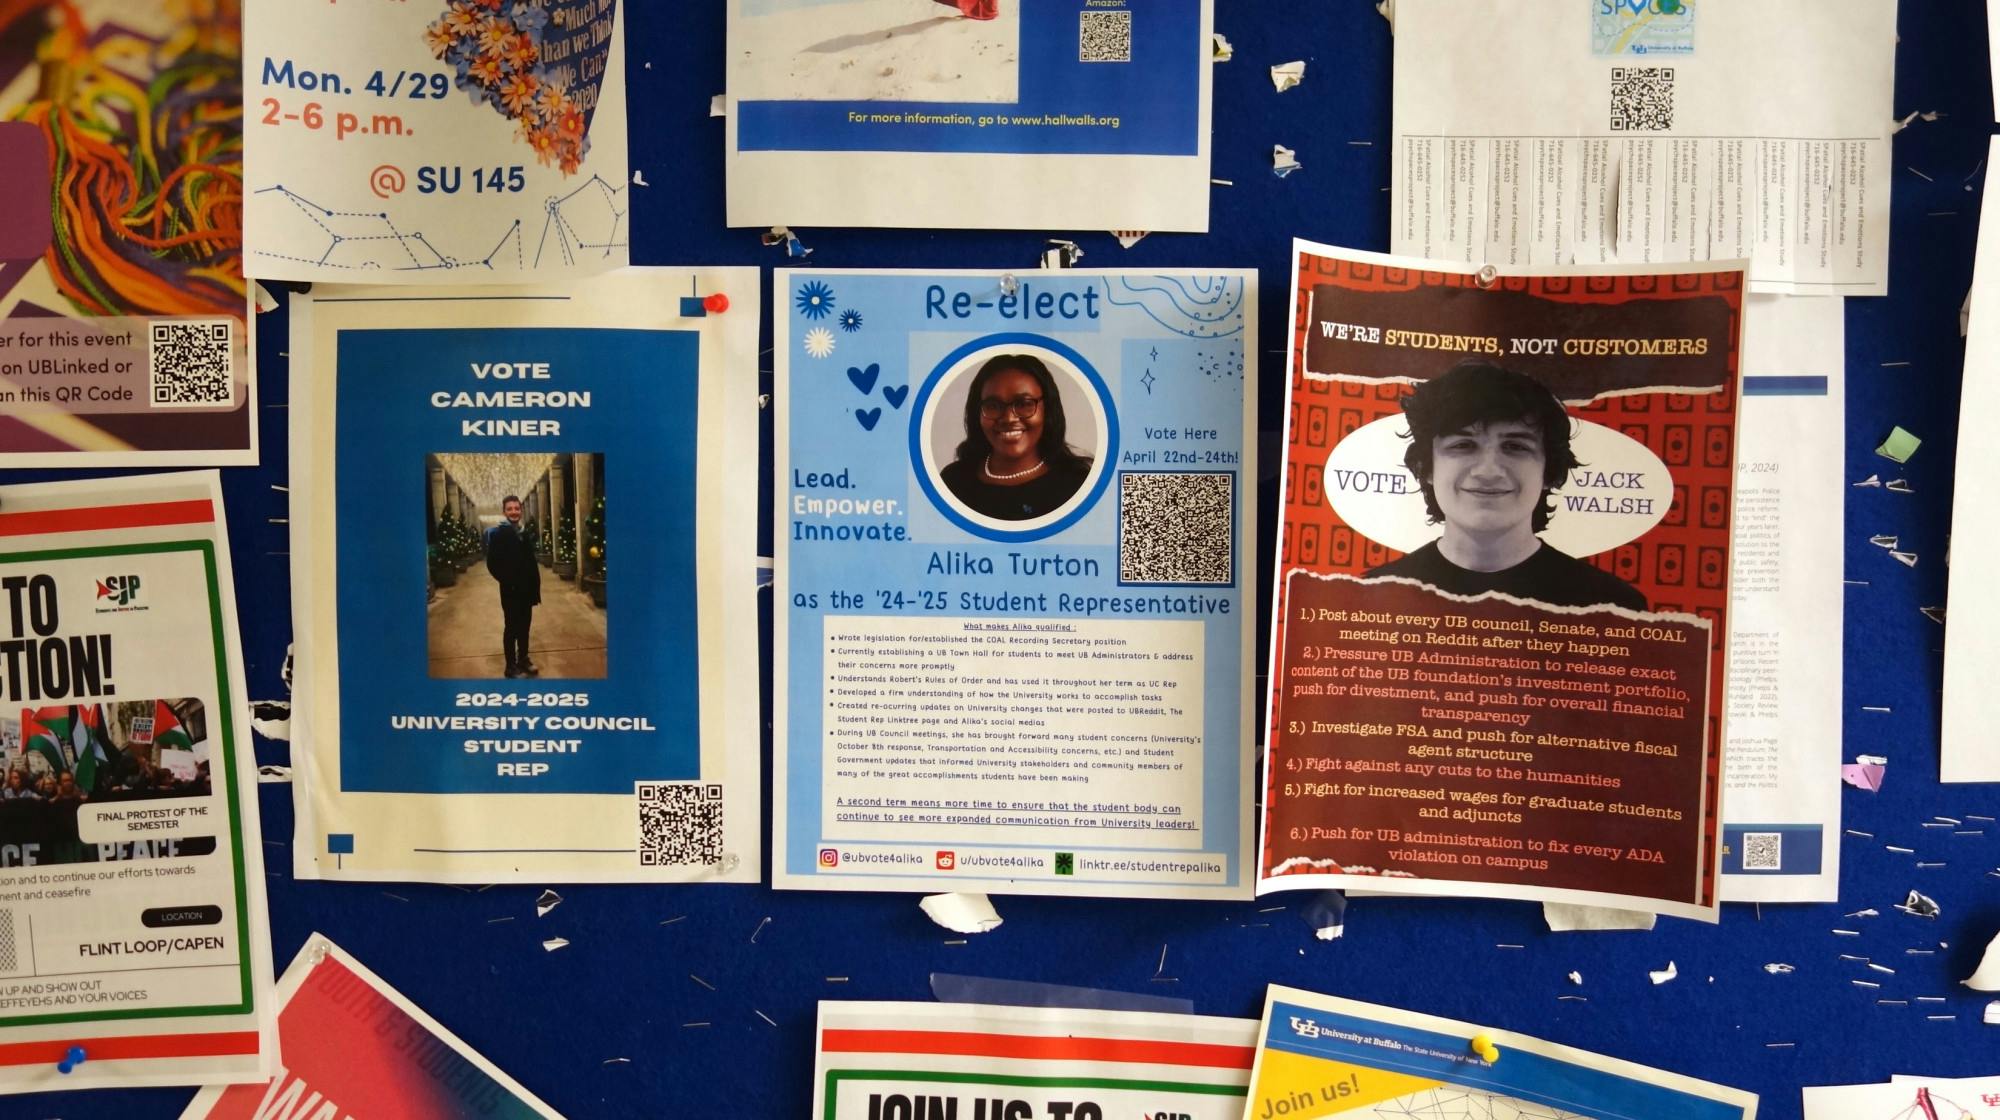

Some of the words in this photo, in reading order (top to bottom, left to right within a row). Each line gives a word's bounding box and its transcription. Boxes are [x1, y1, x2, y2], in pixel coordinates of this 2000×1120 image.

[1085, 0, 1126, 8] Amazon:
[262, 57, 352, 94] Mon.
[364, 70, 449, 99] 4/29
[261, 97, 323, 129] 2-6
[336, 112, 414, 136] p.m.
[848, 111, 868, 122] For
[870, 114, 902, 123] more
[904, 112, 975, 125] information,
[978, 116, 994, 127] go
[996, 114, 1009, 125] to
[1011, 114, 1120, 128] www.hallwalls.org
[370, 165, 405, 198] @
[417, 166, 461, 194] SU
[472, 166, 525, 193] 145
[926, 282, 1100, 320] Re-elect
[18, 331, 44, 347] for
[48, 330, 79, 347] this
[84, 331, 132, 346] event
[1320, 321, 1380, 343] WE'RE
[1384, 329, 1504, 355] STUDENTS,
[1509, 338, 1558, 354] NOT
[1563, 338, 1708, 355] CUSTOMERS
[1, 364, 22, 375] on
[28, 358, 109, 374] UBLinked
[114, 362, 133, 373] or
[470, 362, 551, 379] VOTE
[20, 385, 50, 402] this
[55, 386, 82, 403] QR
[87, 385, 133, 401] Code
[431, 391, 590, 407] CAMERON
[462, 420, 560, 436] KINER
[1144, 427, 1177, 440] Vote
[1184, 427, 1217, 440] Here
[1123, 450, 1156, 465] April
[1163, 450, 1238, 464] 22nd-24th!
[794, 468, 856, 488] Lead.
[1334, 468, 1408, 496] VOTE
[1576, 470, 1646, 490] JACK
[793, 495, 903, 518] Empower.
[1565, 494, 1654, 516] WALSH
[793, 521, 912, 541] Innovate.
[927, 551, 994, 575] Alika
[1007, 552, 1099, 576] Turton
[2, 574, 60, 638] TO
[793, 593, 818, 609] as
[830, 590, 864, 609] the
[876, 590, 948, 610] '24-'25
[960, 591, 1047, 612] Student
[1059, 593, 1230, 615] Representative
[864, 634, 906, 643] legislation
[908, 635, 968, 643] for/established
[986, 636, 1006, 644] COAL
[1009, 636, 1049, 645] Recording
[1052, 637, 1091, 646] Secretary
[1094, 638, 1127, 646] position
[1338, 629, 1400, 644] meeting
[1402, 633, 1422, 643] on
[1425, 632, 1479, 646] Reddit
[1482, 635, 1523, 649] after
[1526, 638, 1564, 654] they
[1567, 640, 1630, 657] happen
[0, 634, 116, 702] TION!
[921, 663, 955, 671] promptly
[455, 692, 589, 706] 2024-2025
[391, 716, 540, 730] UNIVERSITY
[544, 716, 656, 730] COUNCIL
[463, 739, 582, 753] STUDENT
[1407, 744, 1453, 758] agent
[1455, 747, 1533, 762] structure
[497, 762, 549, 776] REP
[1286, 757, 1303, 772] 4.)
[1305, 757, 1342, 772] Fight
[1344, 759, 1402, 773] against
[1404, 763, 1436, 777] any
[1437, 765, 1472, 777] cuts
[1475, 765, 1492, 778] to
[1495, 767, 1523, 780] the
[1526, 769, 1621, 788] humanities
[96, 812, 126, 822] FINAL
[126, 808, 172, 819] PROTEST
[172, 807, 187, 817] OF
[188, 806, 208, 816] THE
[848, 798, 882, 806] second
[886, 798, 906, 807] term
[912, 800, 940, 808] means
[946, 800, 968, 808] more
[973, 800, 992, 808] time
[997, 800, 1008, 809] to
[1012, 802, 1044, 810] ensure
[1049, 802, 1068, 810] that
[1074, 802, 1088, 812] the
[1093, 802, 1130, 812] student
[1134, 803, 1158, 814] body
[1163, 806, 1182, 814] can
[1418, 806, 1449, 818] and
[1452, 808, 1522, 823] adjuncts
[127, 819, 179, 831] SEMESTER
[841, 852, 923, 863] @ubvote4alika
[960, 855, 1044, 867] u/ubvote4alika
[1079, 859, 1221, 873] linktr.ee/studentrepalika
[1388, 849, 1458, 863] violation
[1461, 854, 1482, 865] on
[1485, 856, 1548, 870] campus
[17, 874, 37, 885] and
[39, 874, 50, 884] to
[52, 872, 96, 883] continue
[98, 871, 116, 880] our
[117, 867, 154, 879] efforts
[154, 864, 196, 877] towards
[23, 889, 43, 900] and
[44, 886, 91, 899] ceasefire
[161, 911, 203, 921] LOCATION
[79, 941, 122, 956] FLINT
[124, 936, 224, 954] LOOP/CAPEN
[5, 985, 20, 996] UP
[21, 984, 44, 994] AND
[45, 982, 78, 993] SHOW
[79, 979, 102, 991] OUT
[54, 994, 76, 1006] AND
[79, 992, 108, 1004] YOUR
[109, 990, 148, 1002] VOICES
[1321, 1026, 1364, 1044] University
[1373, 1036, 1402, 1050] Buffalo
[1414, 1046, 1428, 1056] State
[1429, 1048, 1456, 1062] University
[1261, 1086, 1315, 1120] Join
[1321, 1072, 1362, 1102] us!
